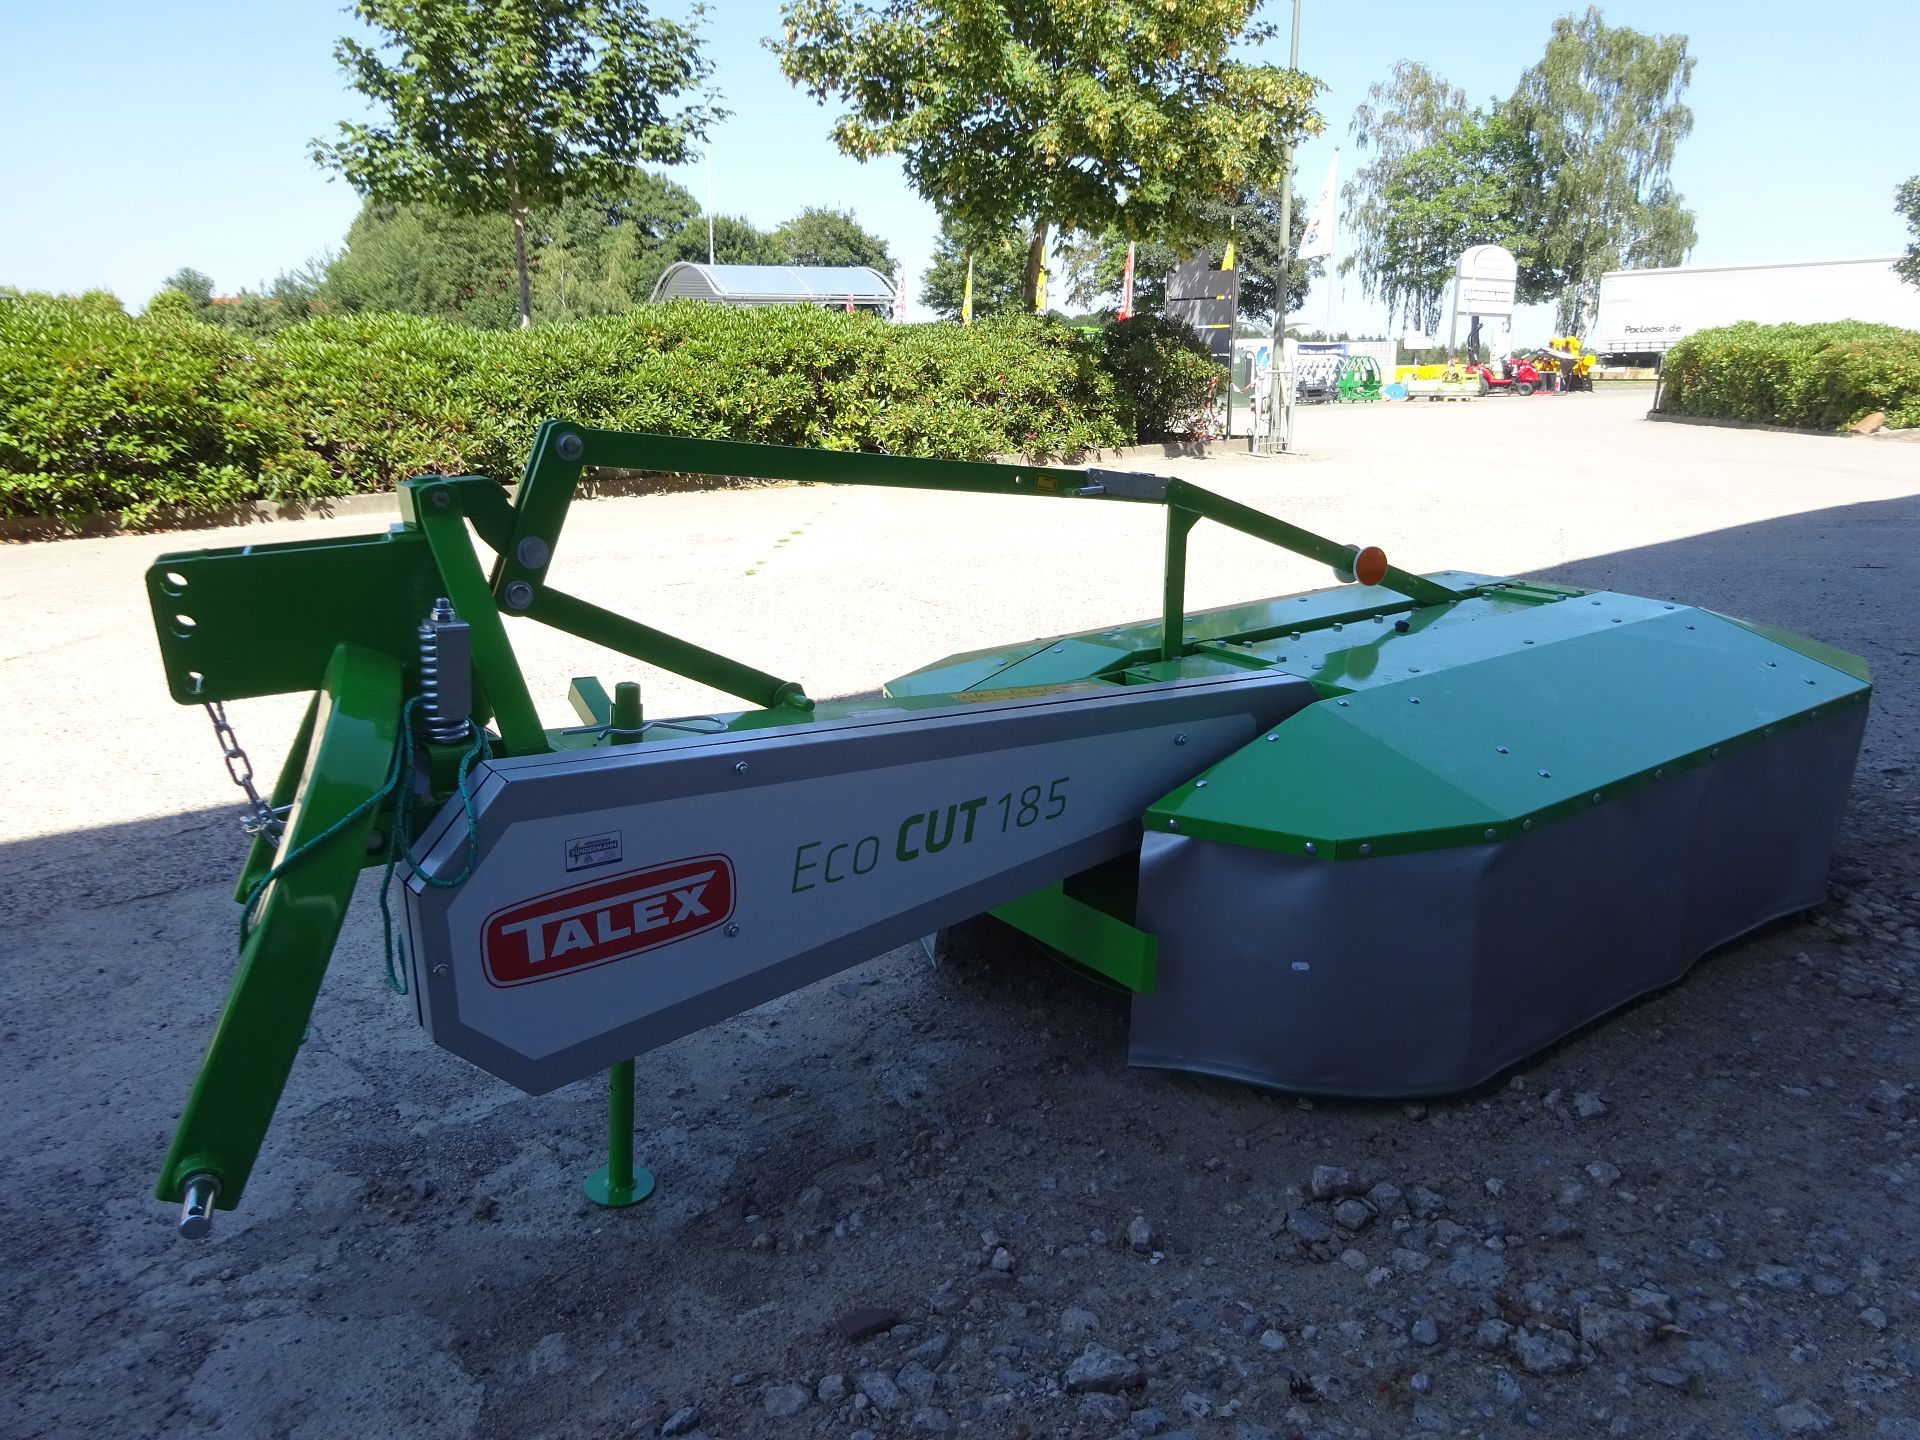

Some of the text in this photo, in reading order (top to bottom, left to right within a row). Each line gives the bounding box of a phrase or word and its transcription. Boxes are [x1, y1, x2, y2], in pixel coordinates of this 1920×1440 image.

[895, 796, 988, 862] CUT
[998, 777, 1070, 833] 185
[501, 869, 717, 964] TALEX
